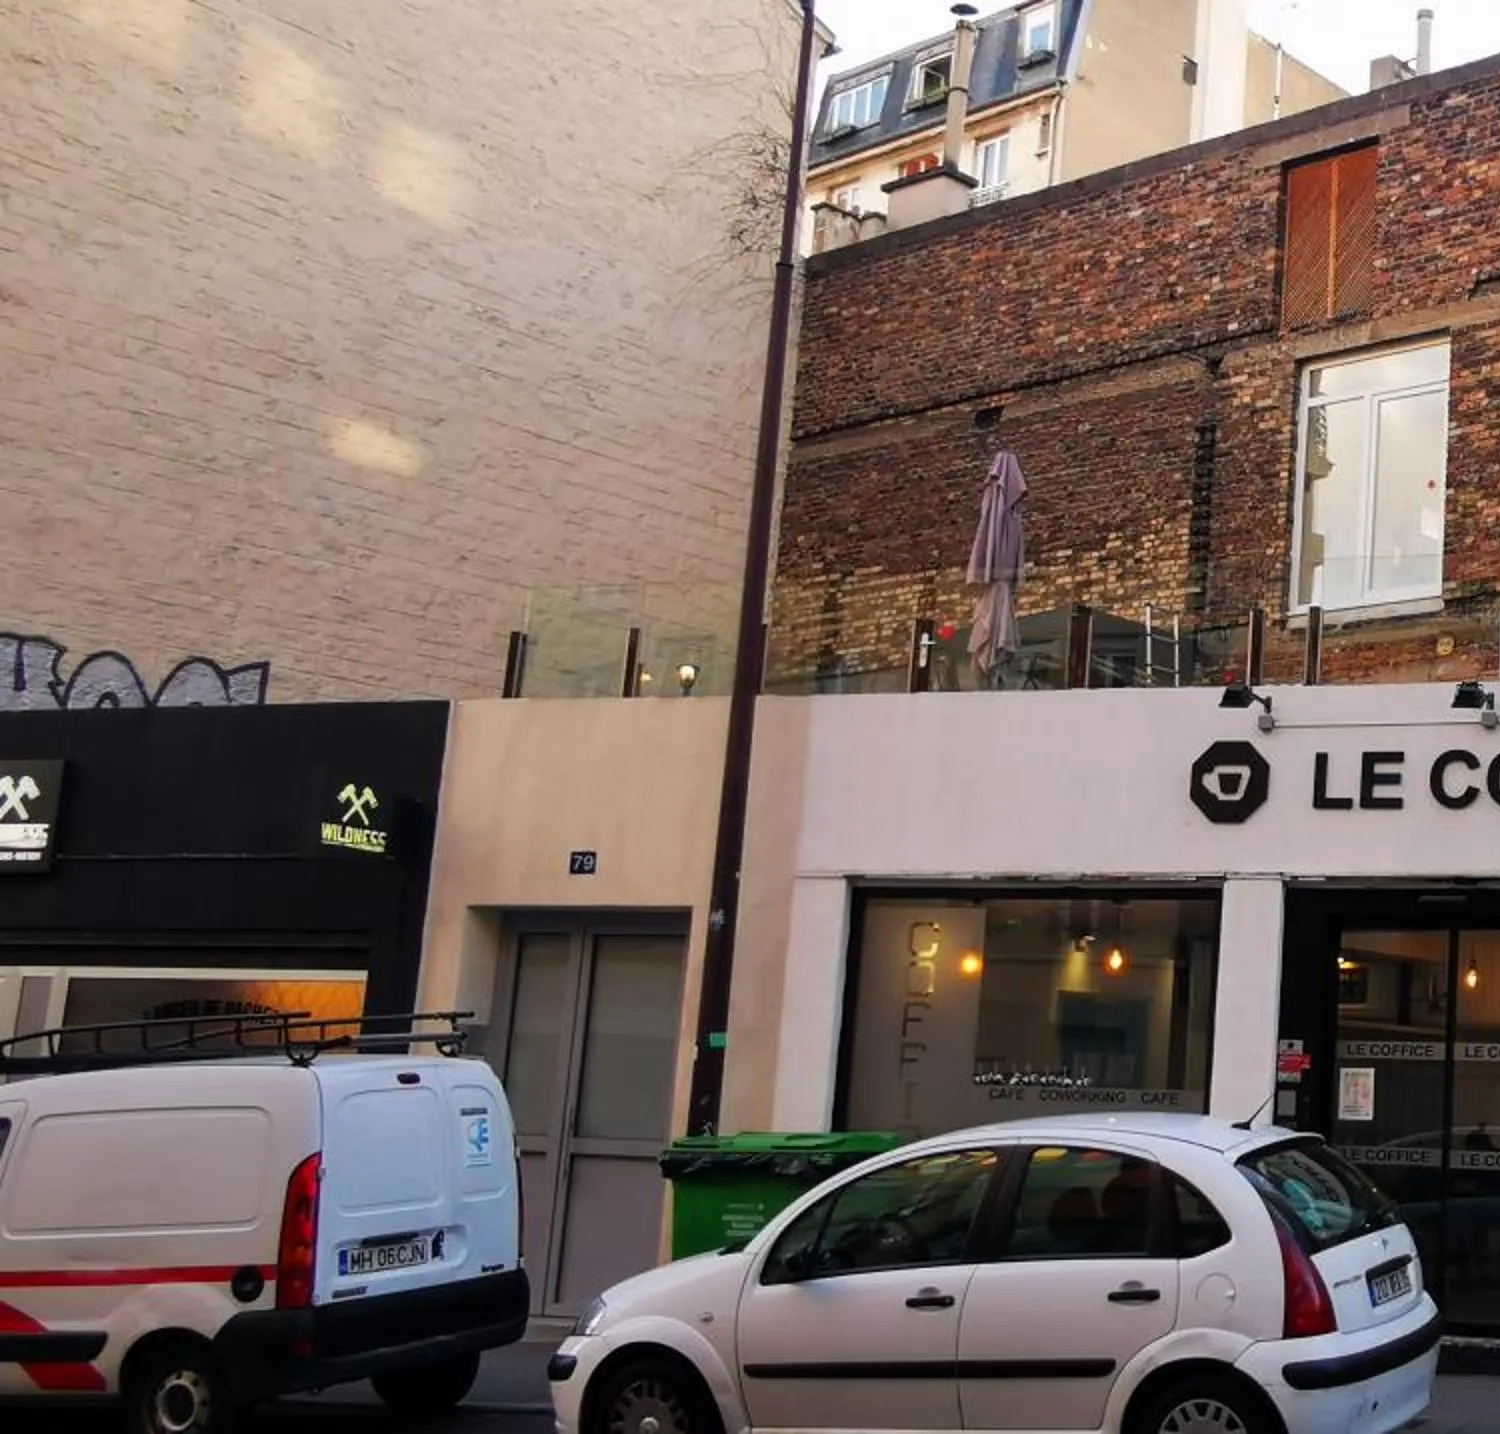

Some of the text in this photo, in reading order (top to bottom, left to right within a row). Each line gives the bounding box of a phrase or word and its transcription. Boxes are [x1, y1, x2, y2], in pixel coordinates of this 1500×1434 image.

[1312, 751, 1405, 809] LE
[573, 855, 593, 870] 79
[898, 920, 941, 1141] COFFI
[1347, 1043, 1434, 1057] LE COFFICE
[1465, 1044, 1484, 1058] LE
[1039, 1088, 1126, 1104] COWORKING
[1365, 1149, 1432, 1163] COFFICE
[1461, 1154, 1480, 1167] LE
